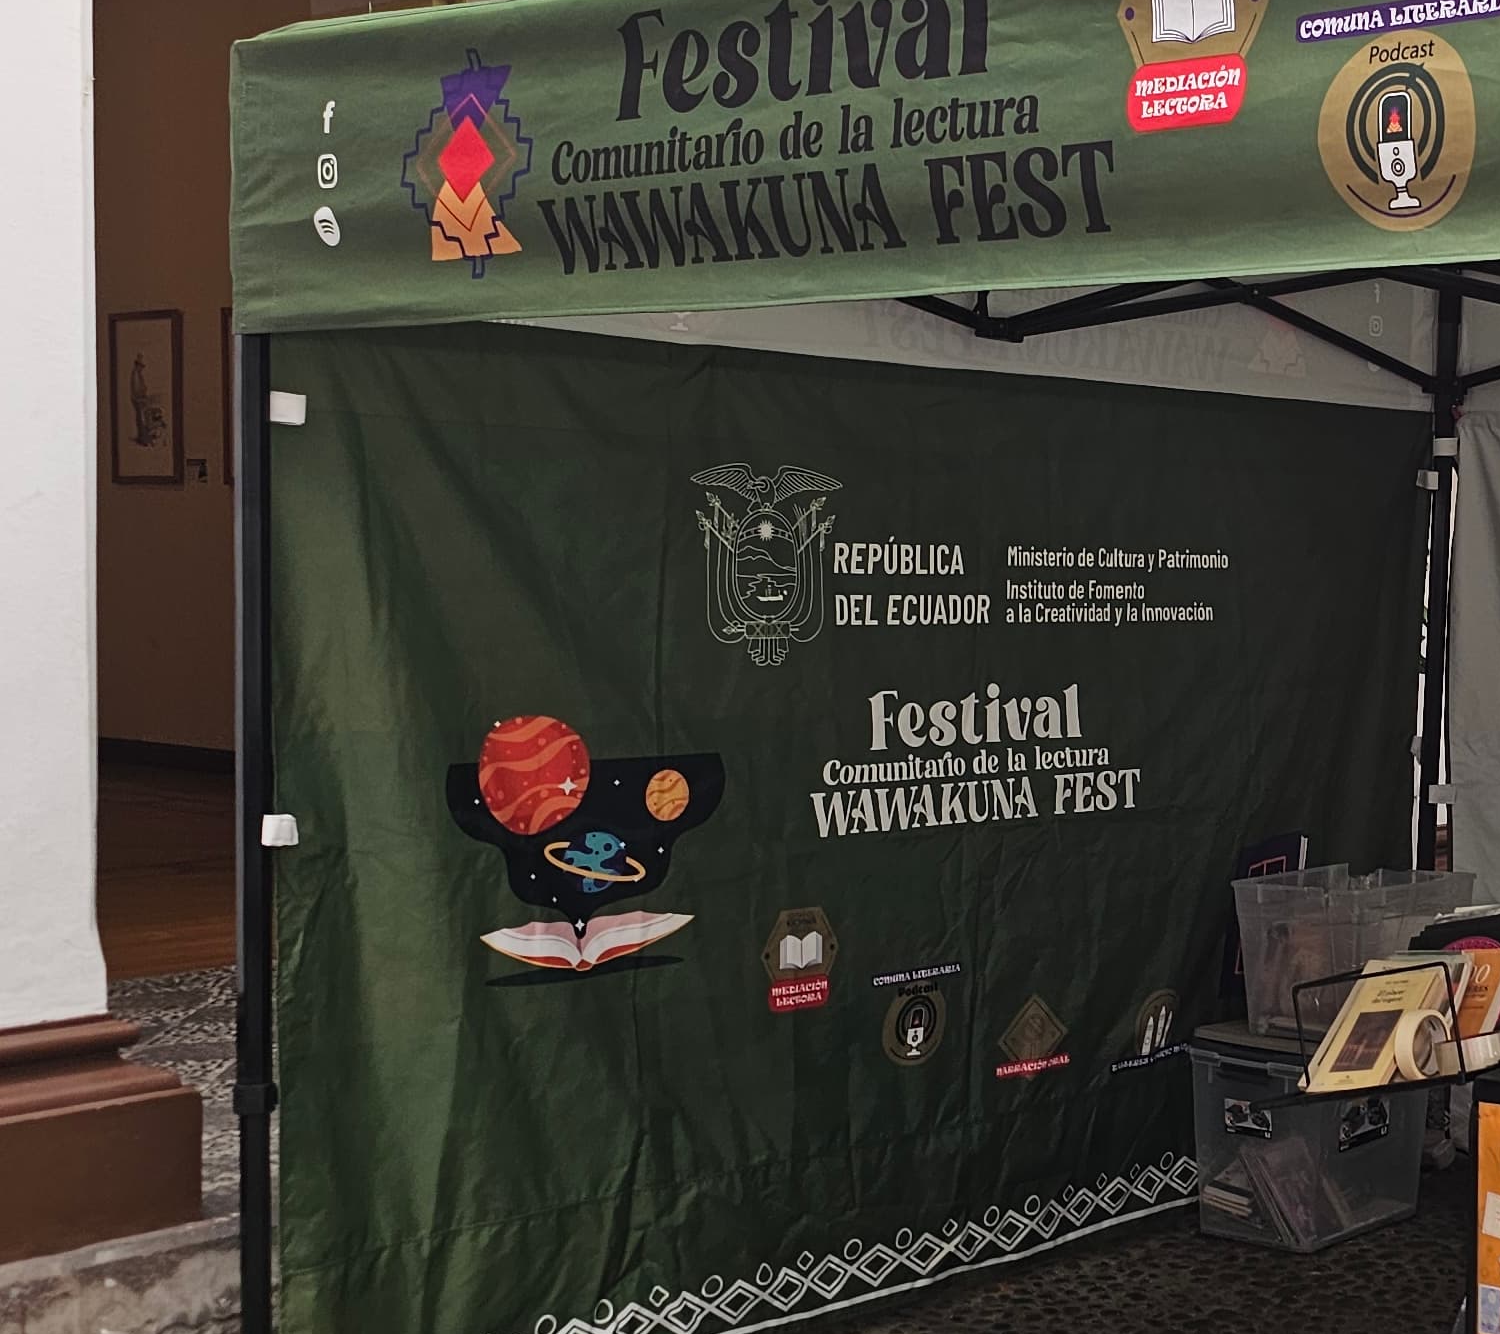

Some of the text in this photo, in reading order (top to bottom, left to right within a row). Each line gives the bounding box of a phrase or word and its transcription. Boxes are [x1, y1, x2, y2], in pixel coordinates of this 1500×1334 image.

[1300, 10, 1384, 39] COMUNA
[1369, 40, 1436, 64] Podcast
[1135, 65, 1241, 97] MEDIACIÓN
[1141, 92, 1228, 118] LECTORA
[550, 92, 1039, 186] Comunitario de la lectura
[536, 139, 1115, 276] WAWAKUNA FEST
[833, 535, 965, 575] REPÚBLICA
[1007, 545, 1229, 573] Ministerio de Cultura y Patrimonio
[1006, 579, 1145, 600] Instituto de Fomento
[835, 594, 991, 626] DEL ECUADOR
[1006, 601, 1214, 627] a la Creatividad y la Innovación
[867, 682, 1082, 751] Festival
[822, 745, 1110, 786] Comunitario de la lectura
[810, 768, 1141, 838] WAWAKUNA FEST
[771, 980, 828, 997] MEDIACIÓN
[776, 992, 822, 1007] LECTORA
